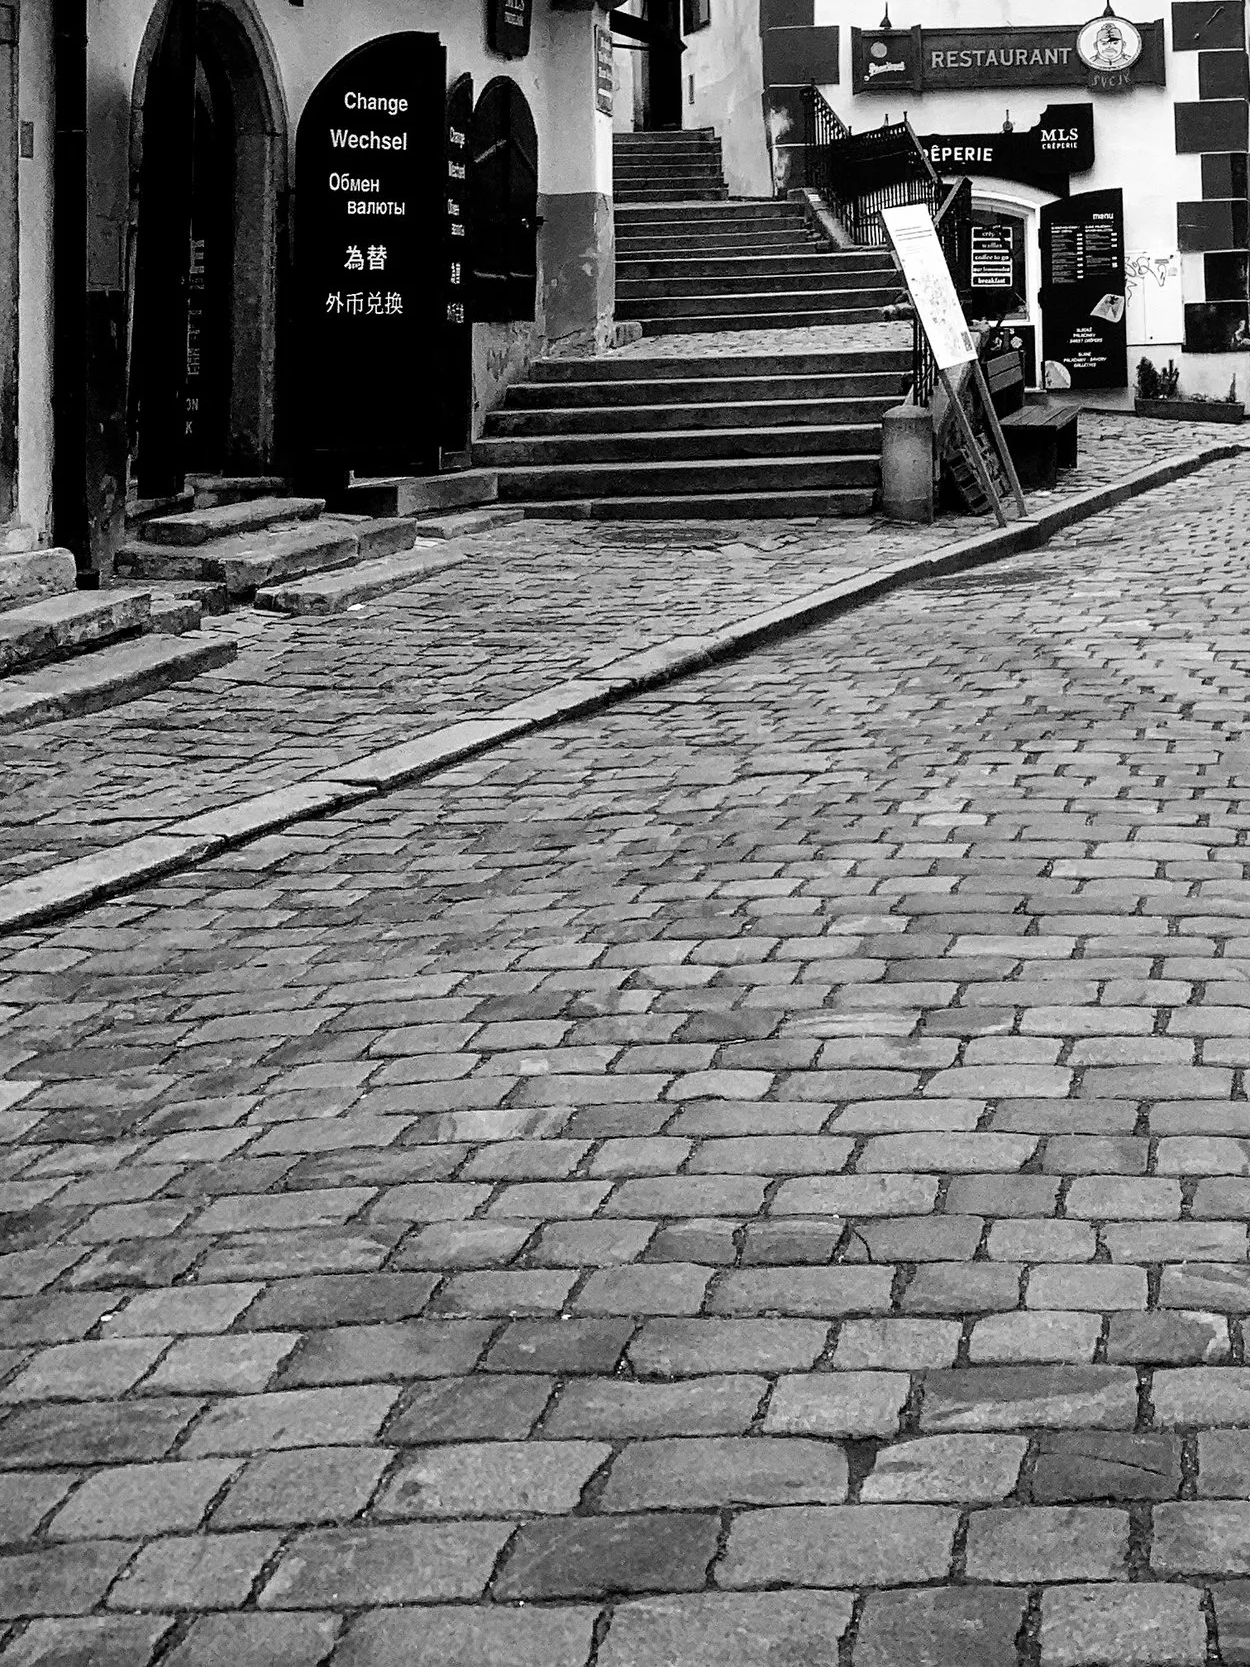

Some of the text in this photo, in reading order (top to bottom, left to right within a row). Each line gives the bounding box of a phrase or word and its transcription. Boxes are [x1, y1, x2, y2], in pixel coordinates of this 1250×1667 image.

[931, 47, 1072, 68] RESTAURANT
[344, 91, 409, 115] Change
[330, 129, 408, 151] Wechsel
[1040, 128, 1079, 142] MLS
[329, 172, 380, 193] Обмен
[347, 200, 406, 216] валюты
[344, 244, 388, 271] 為替
[325, 291, 404, 316] 外币兑换
